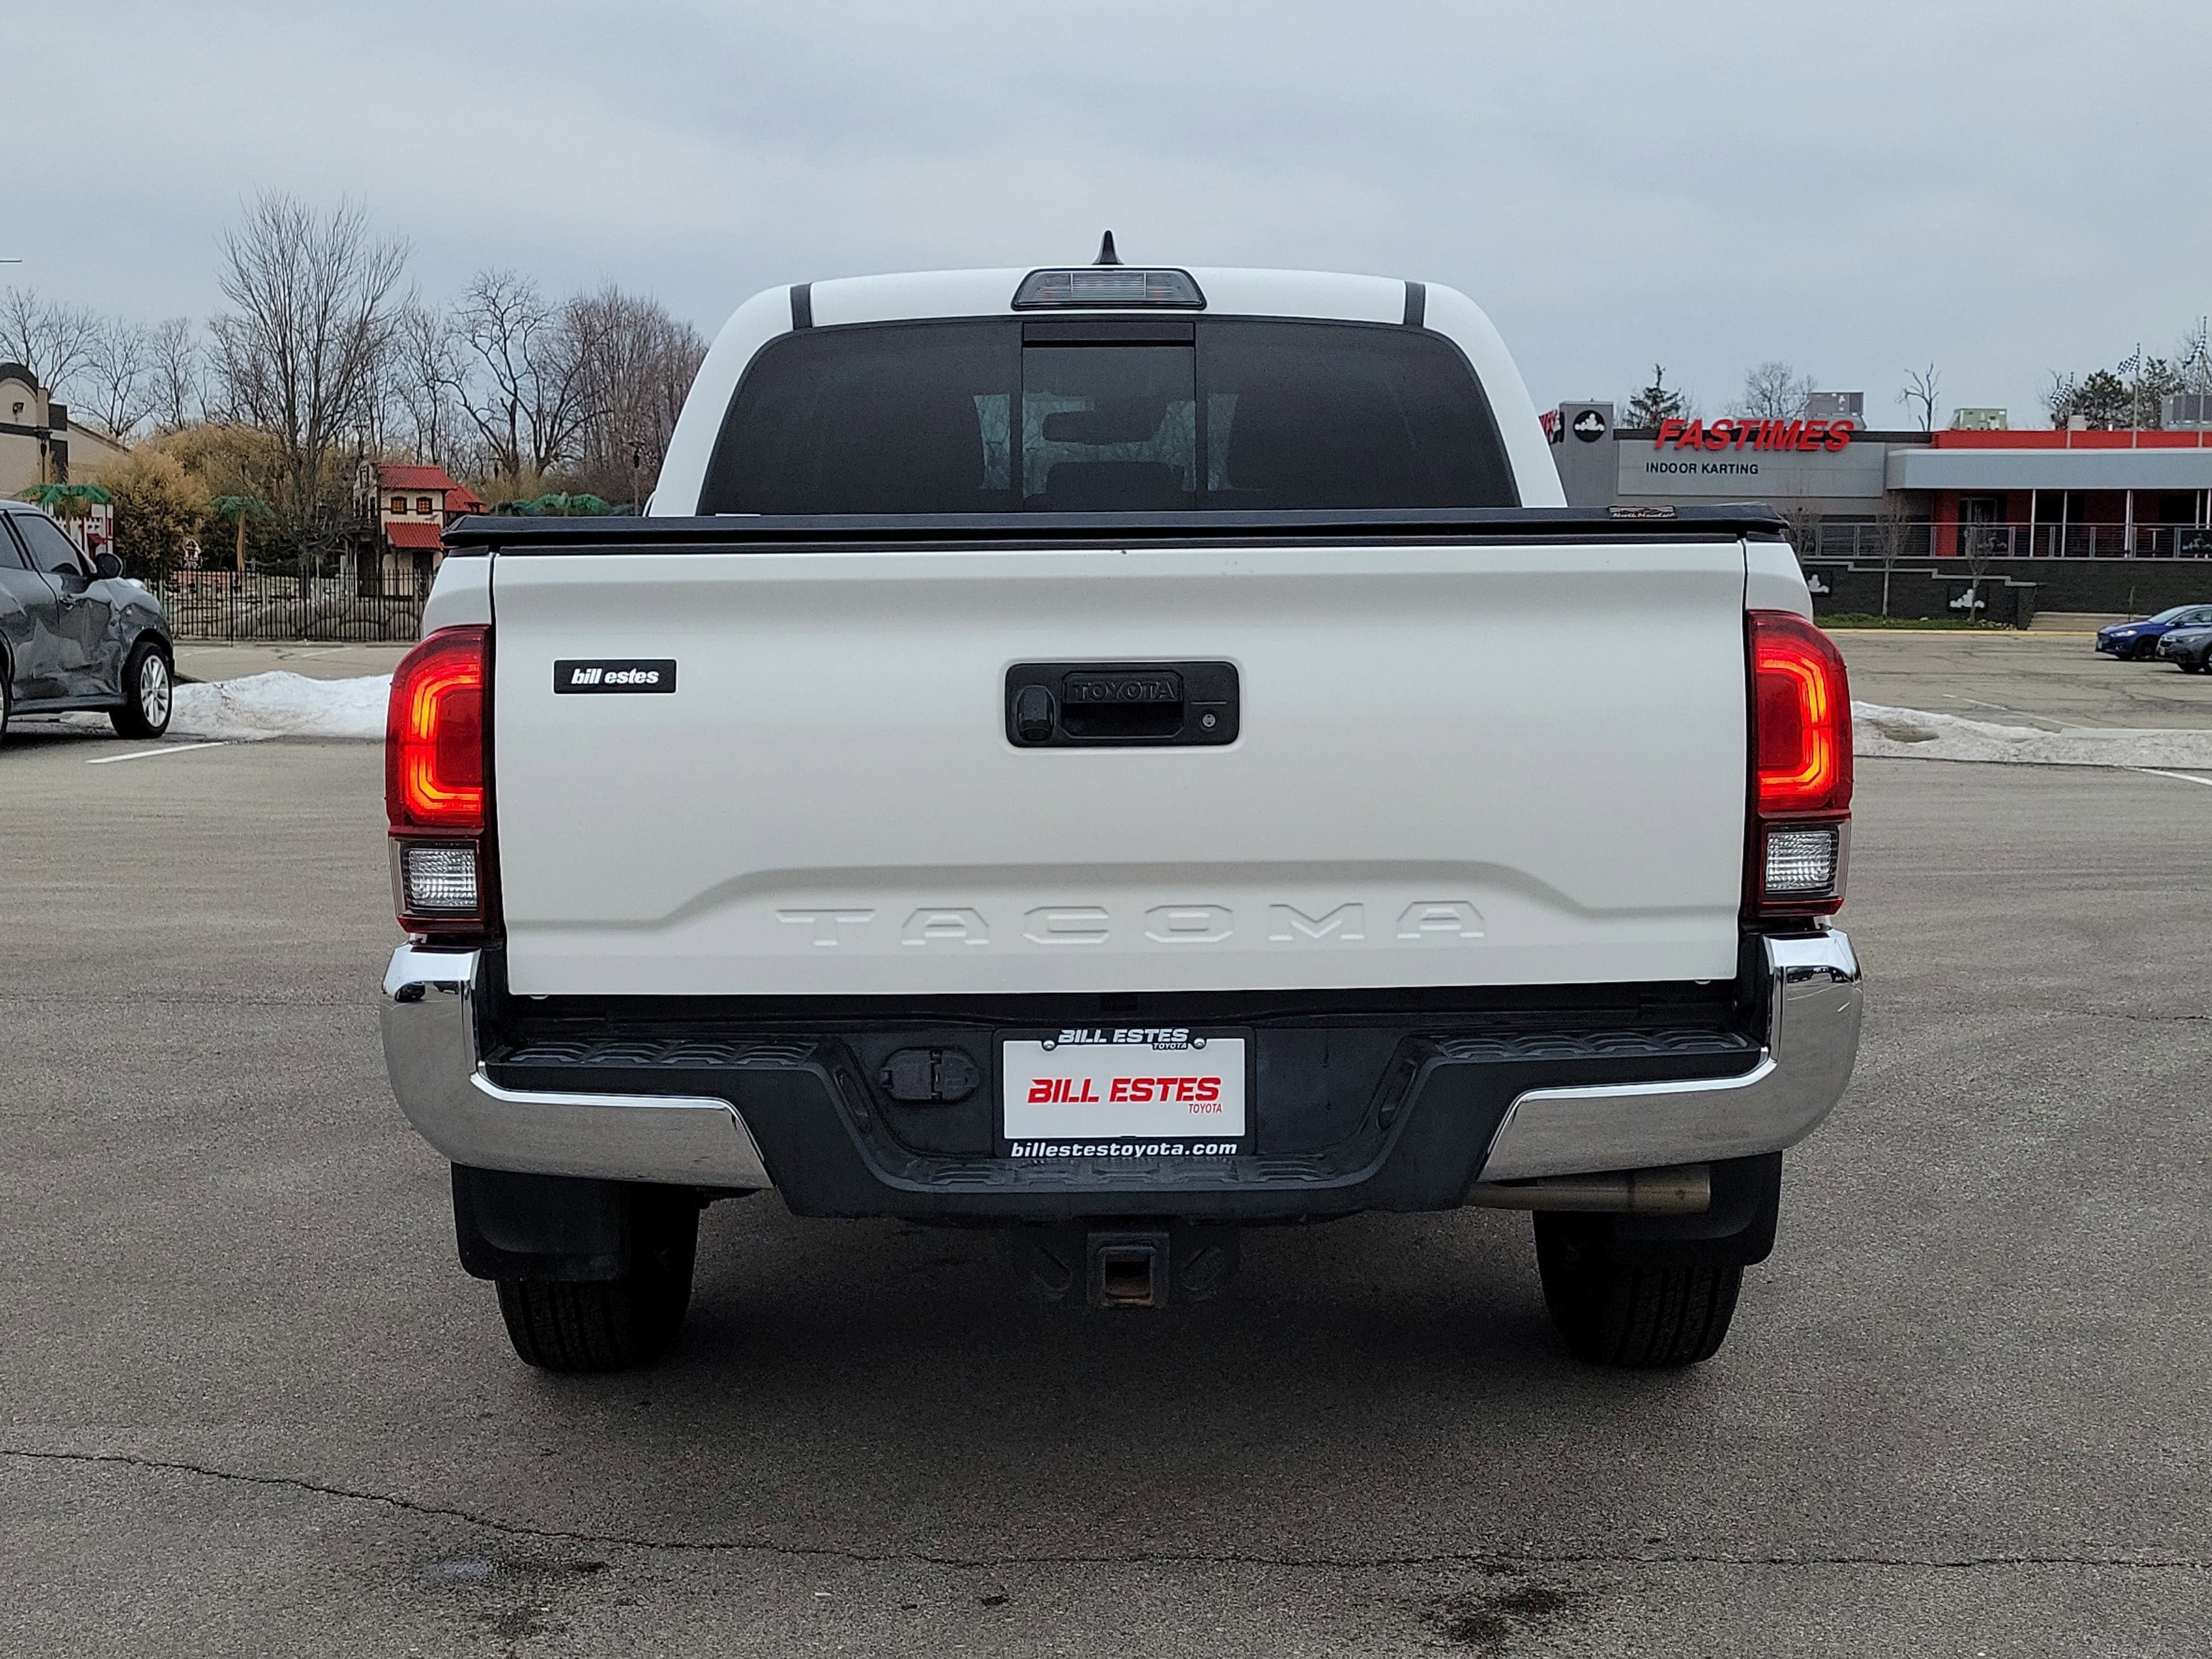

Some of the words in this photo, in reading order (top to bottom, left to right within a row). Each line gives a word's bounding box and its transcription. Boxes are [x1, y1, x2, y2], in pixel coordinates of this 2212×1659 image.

[1655, 418, 1855, 452] FASTIMES
[1646, 462, 1697, 473] INDOOR
[1701, 463, 1758, 475] KARTING
[571, 668, 602, 684] bill
[604, 668, 659, 684] estes
[1073, 680, 1176, 701] TOYOTA
[775, 900, 1485, 946] TACOMA
[1058, 1029, 1107, 1042] BILL
[1113, 1029, 1189, 1042] ESTES
[1028, 1079, 1099, 1103] BILL
[1109, 1077, 1221, 1102] ESTES
[1189, 1103, 1222, 1113] TOYOTA
[1011, 1142, 1237, 1158] billestestoyota.com
